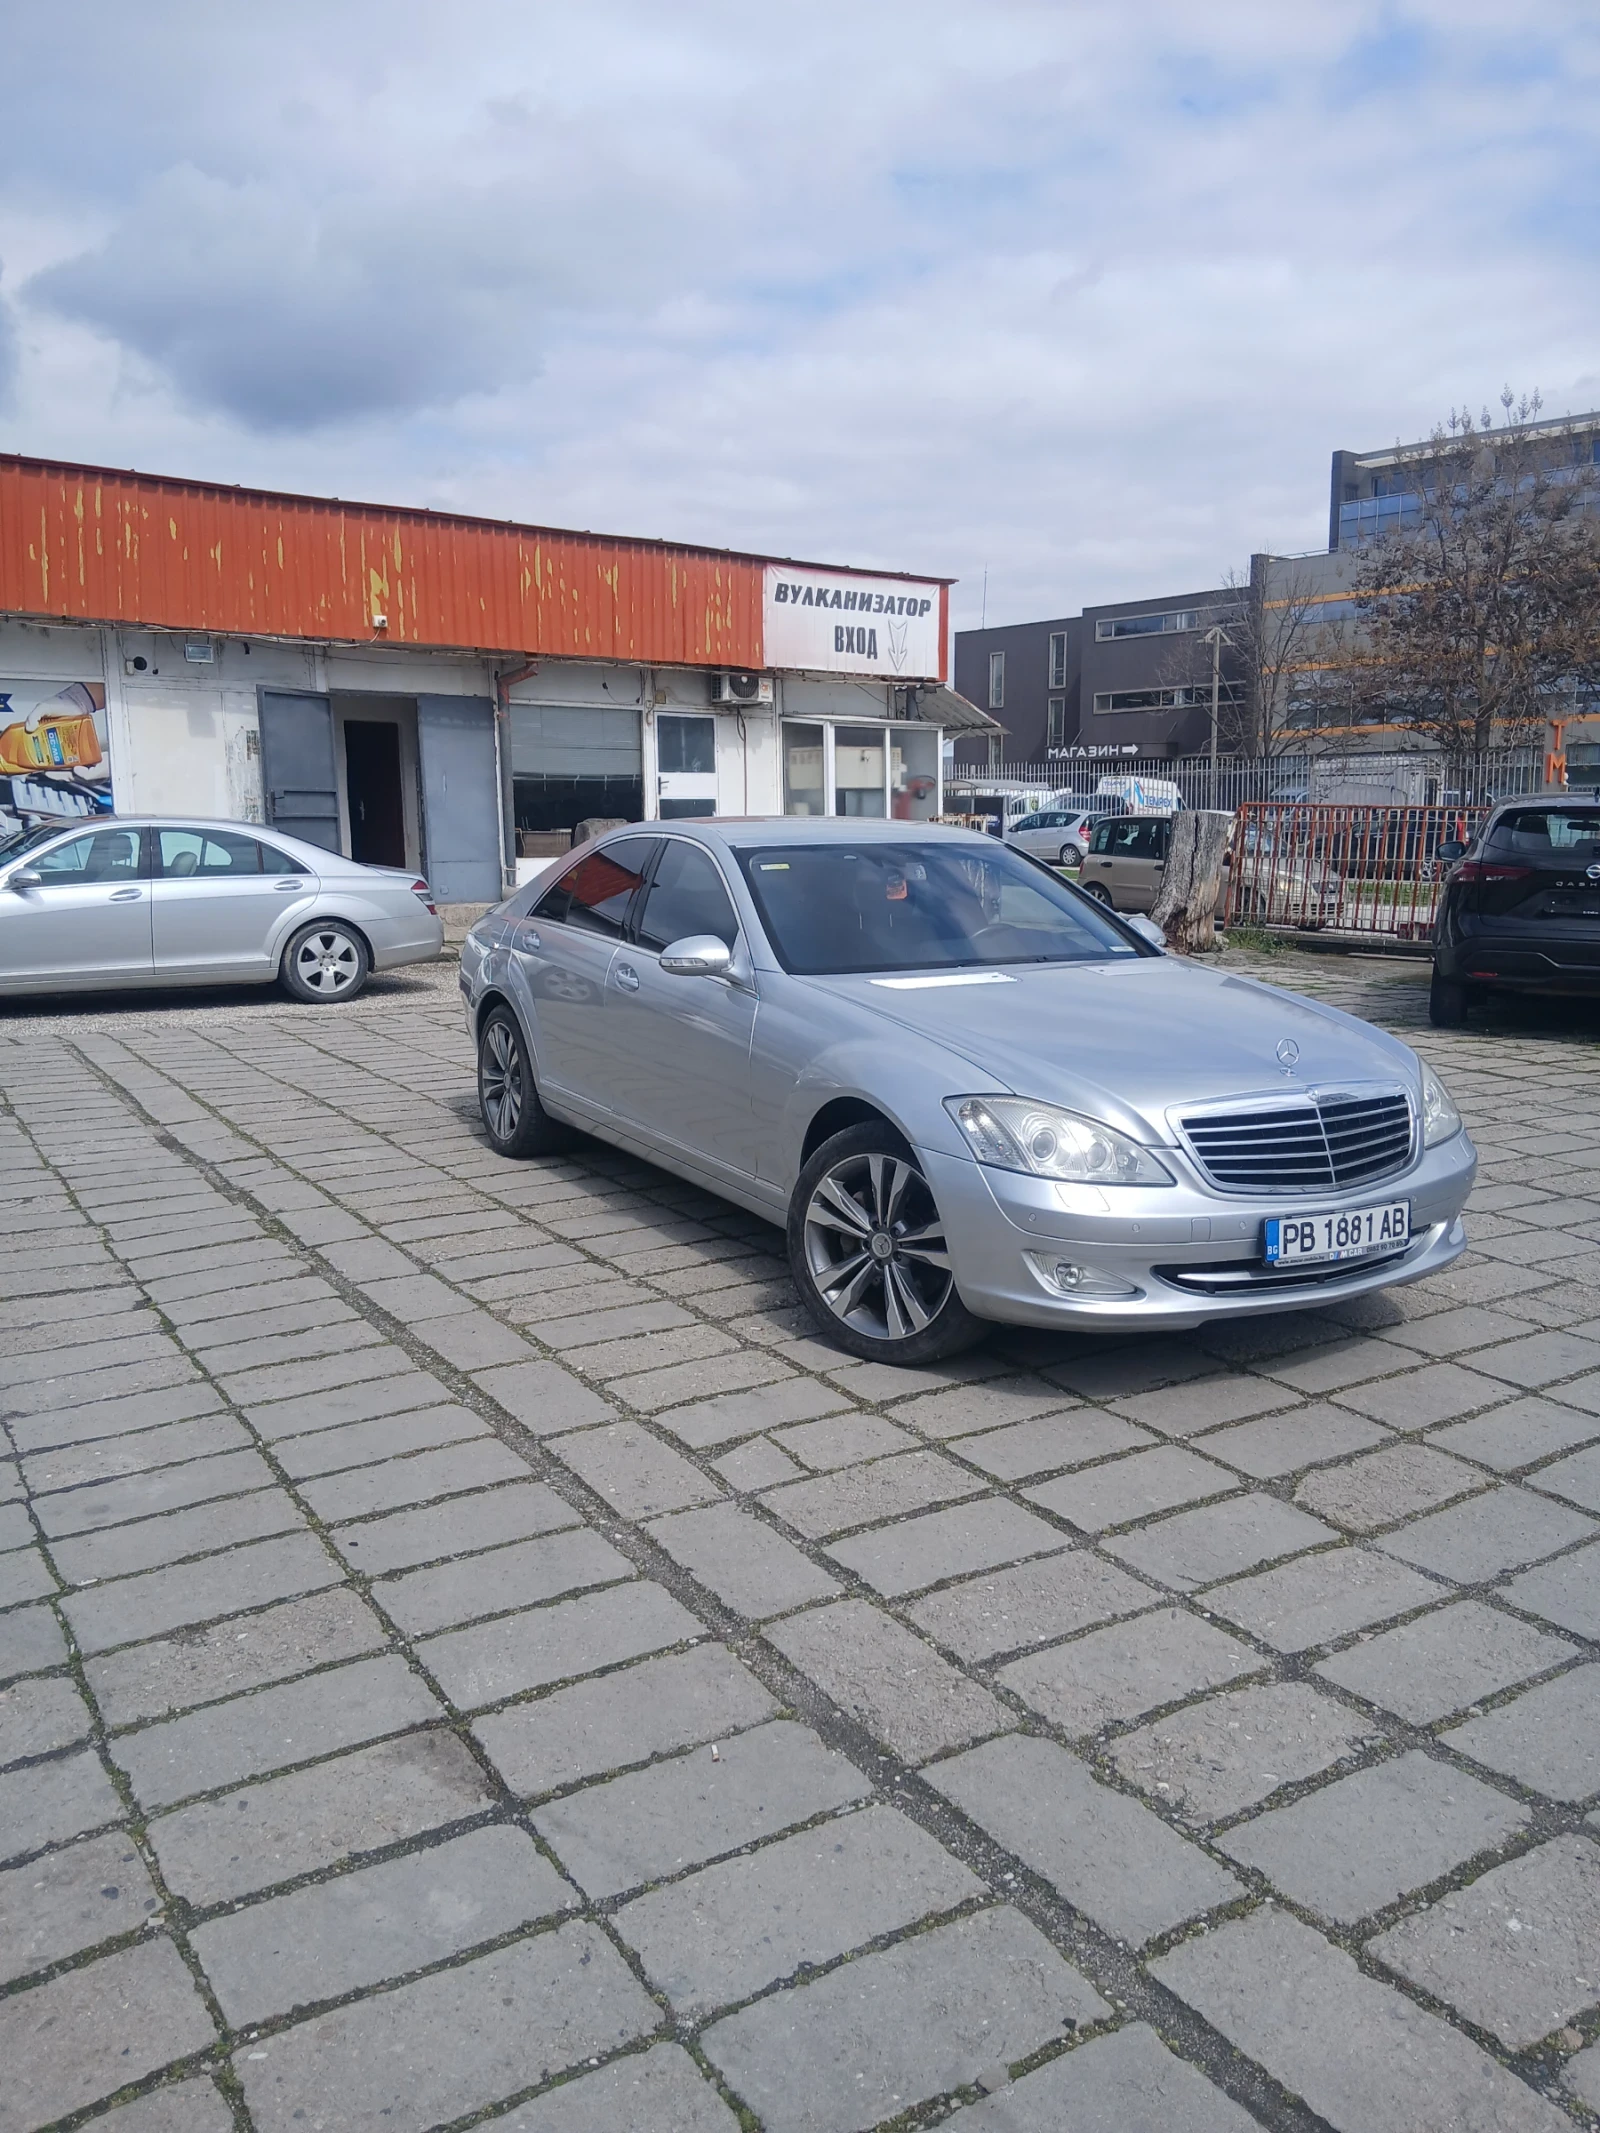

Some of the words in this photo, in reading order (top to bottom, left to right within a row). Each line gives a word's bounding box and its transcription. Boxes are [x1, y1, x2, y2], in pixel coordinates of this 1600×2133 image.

[774, 582, 932, 618] ВУЛКАНИЗАТОР
[834, 625, 878, 660] ВХОД
[1048, 744, 1119, 760] МАГАЗИН
[1282, 1221, 1316, 1255] PB
[1324, 1212, 1374, 1250] 1881
[1380, 1207, 1406, 1240] AB
[1267, 1245, 1278, 1256] BG
[1349, 1248, 1363, 1257] CAR
